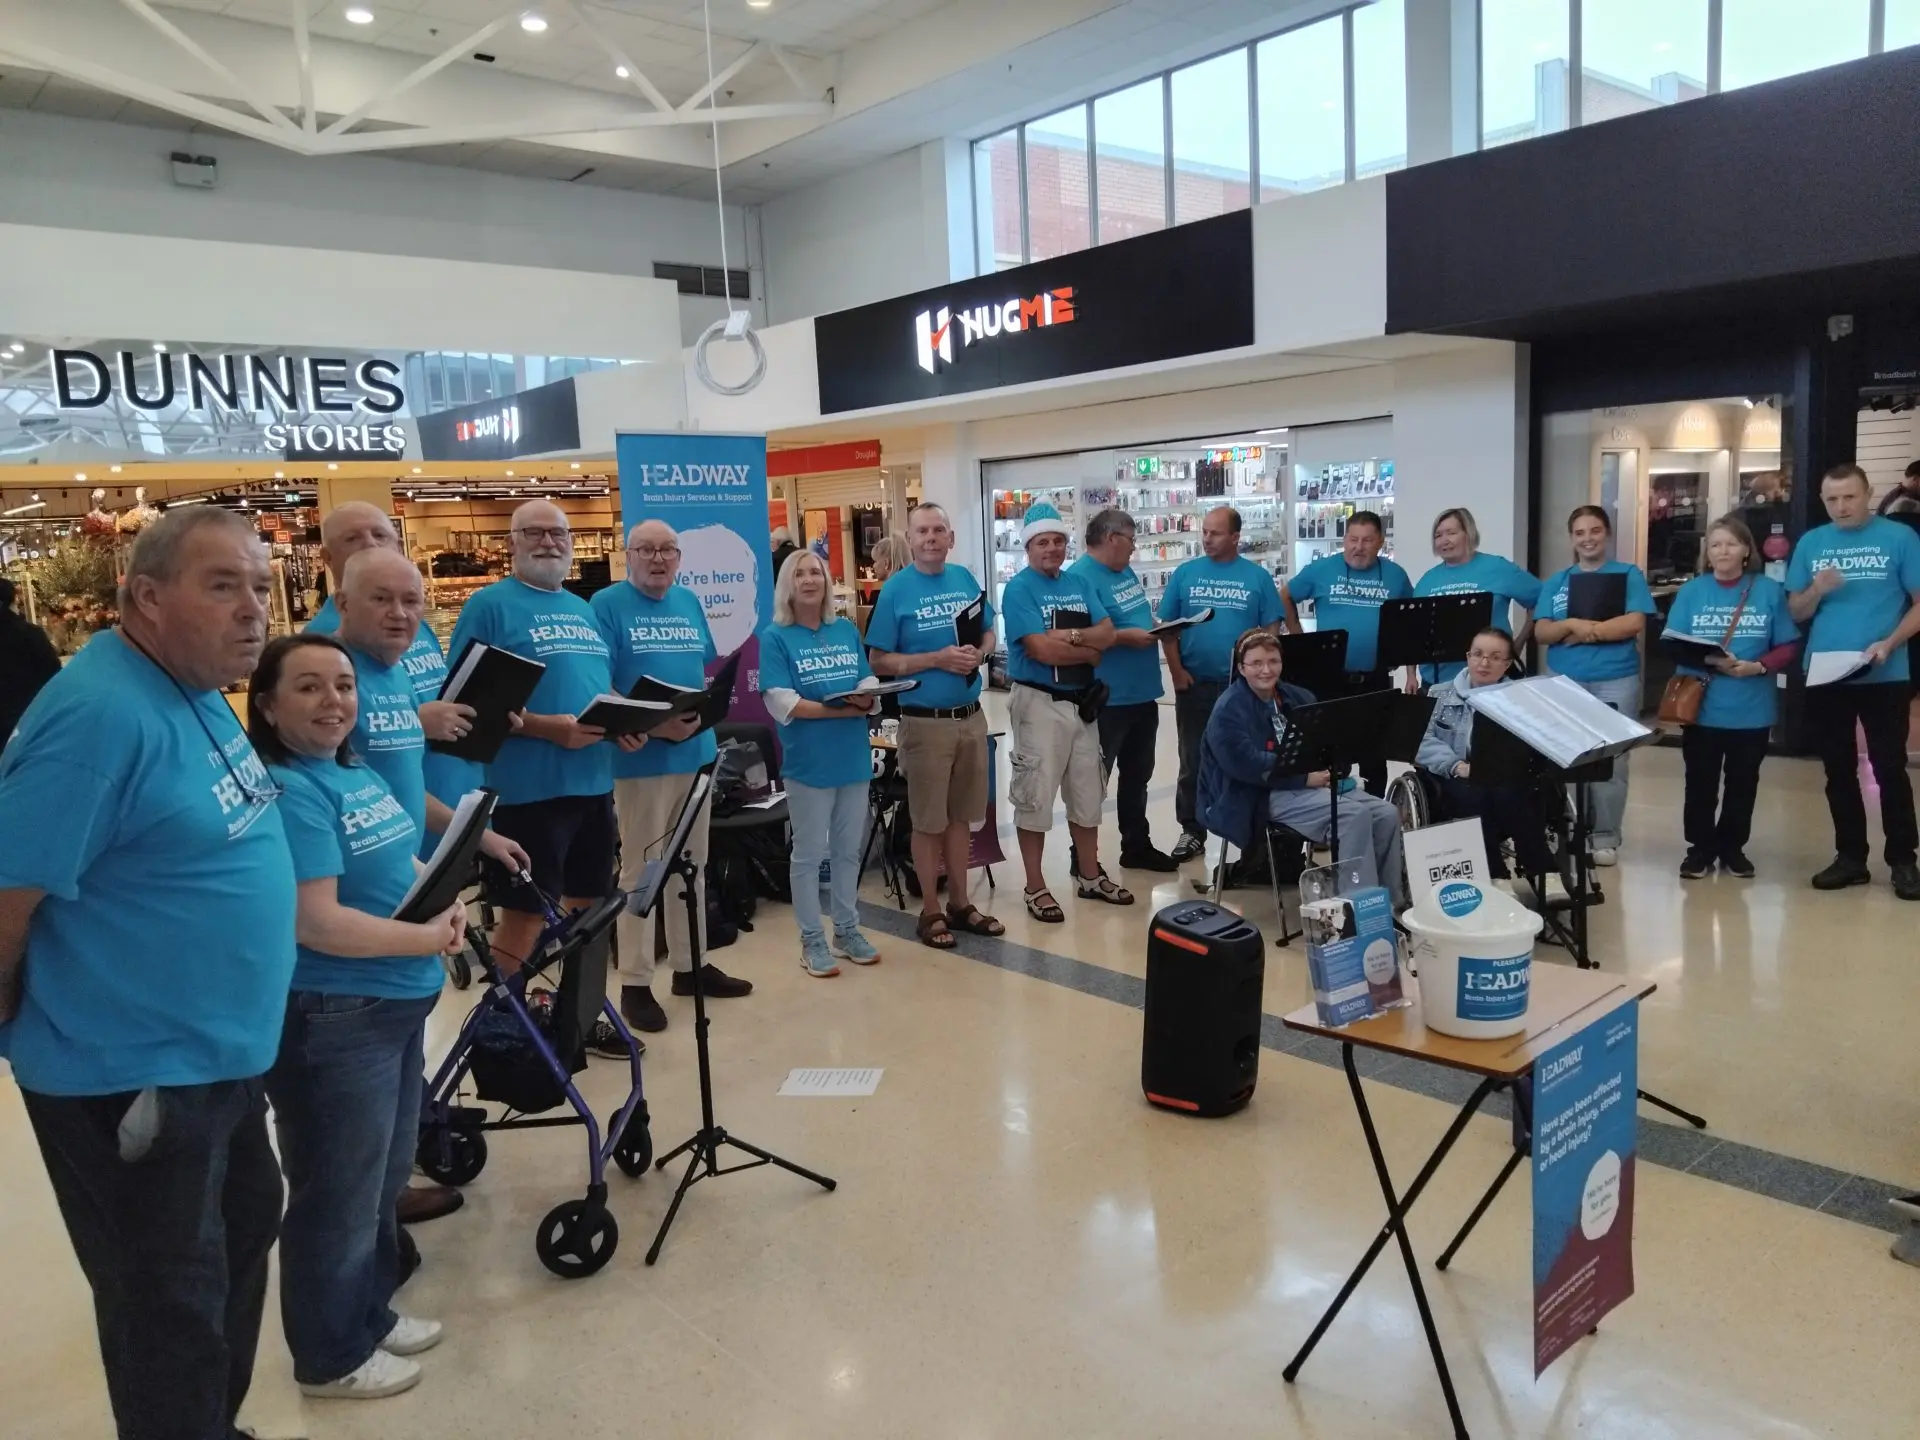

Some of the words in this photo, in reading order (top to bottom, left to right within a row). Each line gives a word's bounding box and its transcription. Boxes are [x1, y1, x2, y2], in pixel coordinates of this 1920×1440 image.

[50, 348, 405, 415] DUNNES
[263, 423, 406, 451] STORES
[855, 450, 877, 459] Douglas
[640, 464, 750, 486] HEADWAY
[643, 493, 663, 502] Brain
[664, 493, 686, 503] Injury
[687, 493, 716, 502] Services
[717, 493, 723, 501] &
[724, 493, 753, 502] Support
[1836, 546, 1881, 555] supporting
[1812, 556, 1890, 572] HEADWAY
[712, 570, 745, 584] here
[1348, 578, 1384, 588] supporting
[1210, 580, 1245, 589] supporting
[1441, 582, 1478, 592] supporting
[919, 597, 933, 605] I'm
[933, 591, 968, 601] supporting
[1189, 586, 1251, 601] HEADWAY
[1329, 584, 1390, 600] HEADWAY
[704, 594, 735, 609] you.
[533, 614, 551, 623] I'm
[634, 616, 650, 624] I'm
[650, 616, 690, 625] supporting
[628, 626, 700, 641] HEADWAY
[799, 648, 813, 656] I'm
[812, 644, 850, 655] supporting
[795, 653, 859, 674] HEADWAY
[370, 693, 387, 705] I'm
[368, 738, 391, 746] Brain
[350, 832, 379, 850] Brain
[1493, 959, 1515, 967] PLEASE
[1464, 993, 1485, 1002] Brain
[1542, 1044, 1583, 1084] HEADWAY
[1540, 1117, 1559, 1137] Have
[1559, 1106, 1574, 1126] you
[1574, 1094, 1592, 1113] been
[1593, 1071, 1622, 1100] affected
[1540, 1140, 1551, 1155] by
[1551, 1135, 1557, 1147] a
[1557, 1121, 1577, 1142] brain
[1577, 1107, 1600, 1128] injury,
[1600, 1091, 1621, 1112] stroke
[1540, 1158, 1549, 1173] or
[1549, 1141, 1567, 1167] head
[1568, 1124, 1593, 1152] injury?
